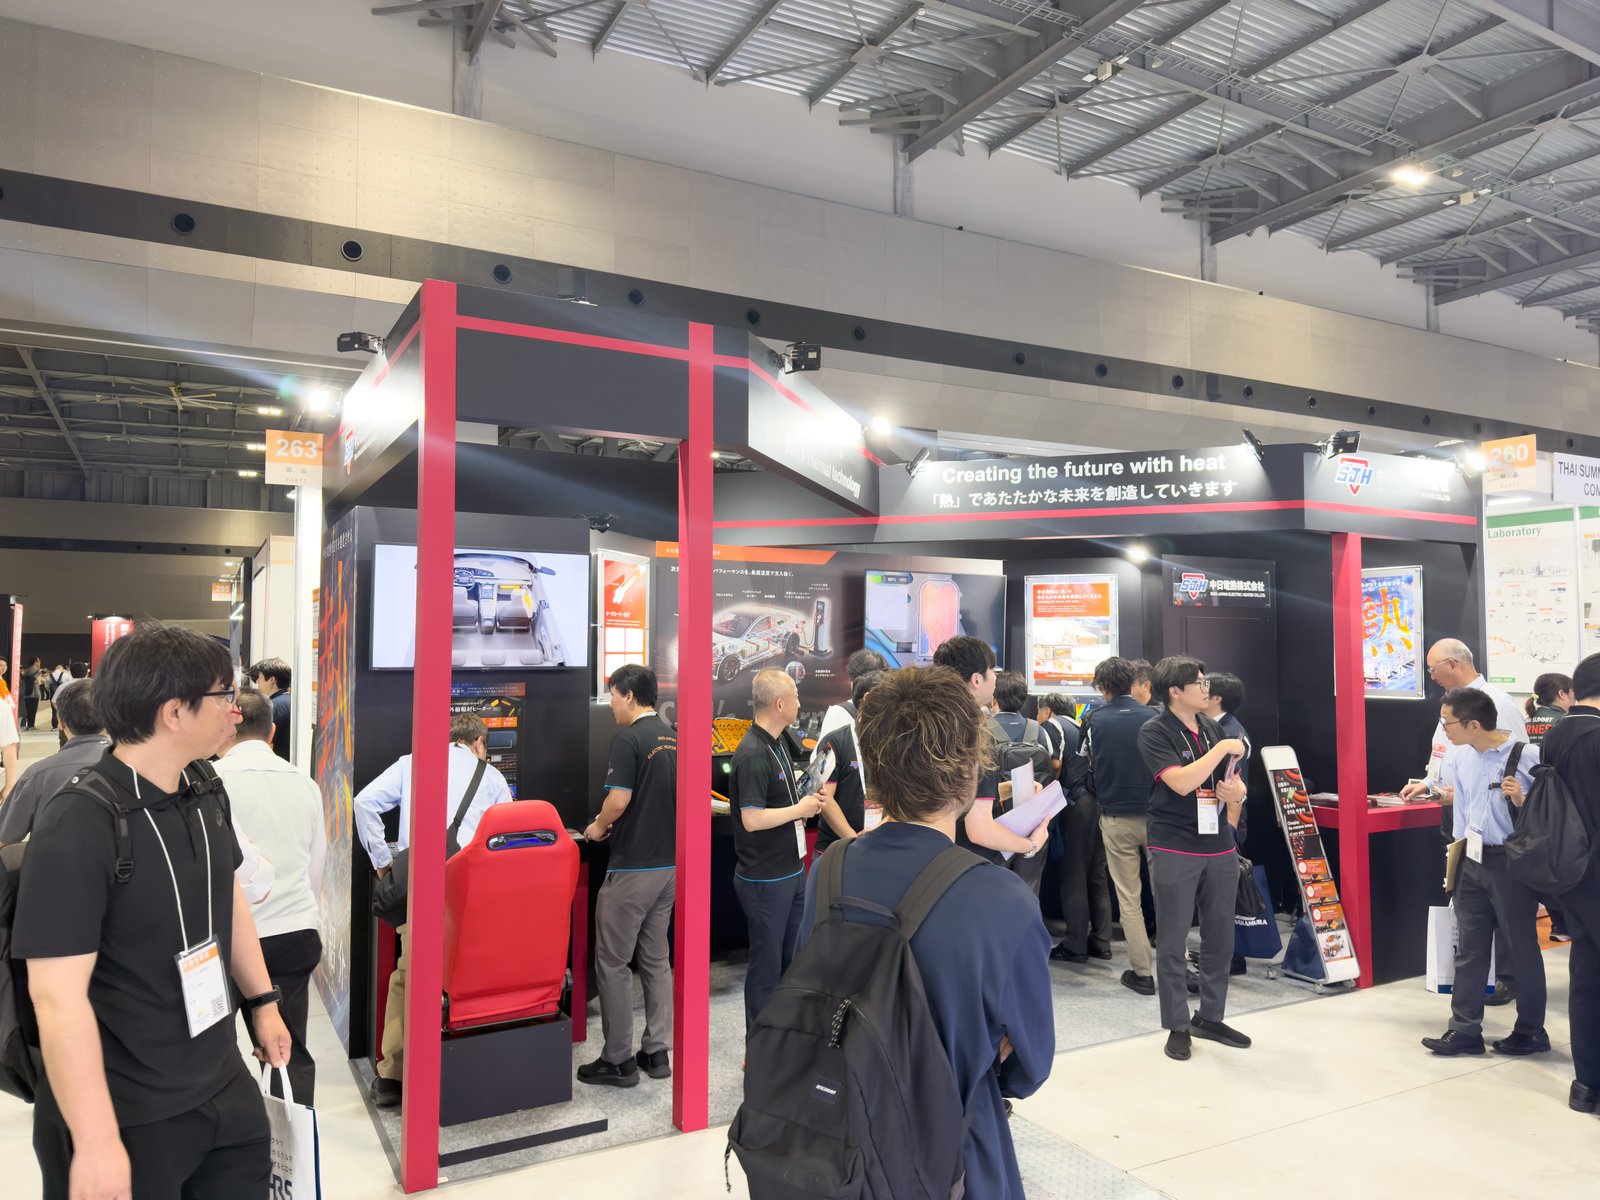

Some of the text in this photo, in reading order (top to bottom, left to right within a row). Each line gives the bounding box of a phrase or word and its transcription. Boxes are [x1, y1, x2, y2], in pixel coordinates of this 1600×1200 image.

[275, 438, 318, 459] 263
[1490, 444, 1529, 464] 260
[942, 454, 1226, 484] Creating the future with heat
[1558, 461, 1578, 477] THAI
[832, 466, 861, 499] technology
[1487, 527, 1542, 539] Laboratory
[1180, 579, 1208, 592] SJH
[1209, 579, 1266, 592] 中日電熱株式会社
[271, 1149, 293, 1162] せるクルマ
